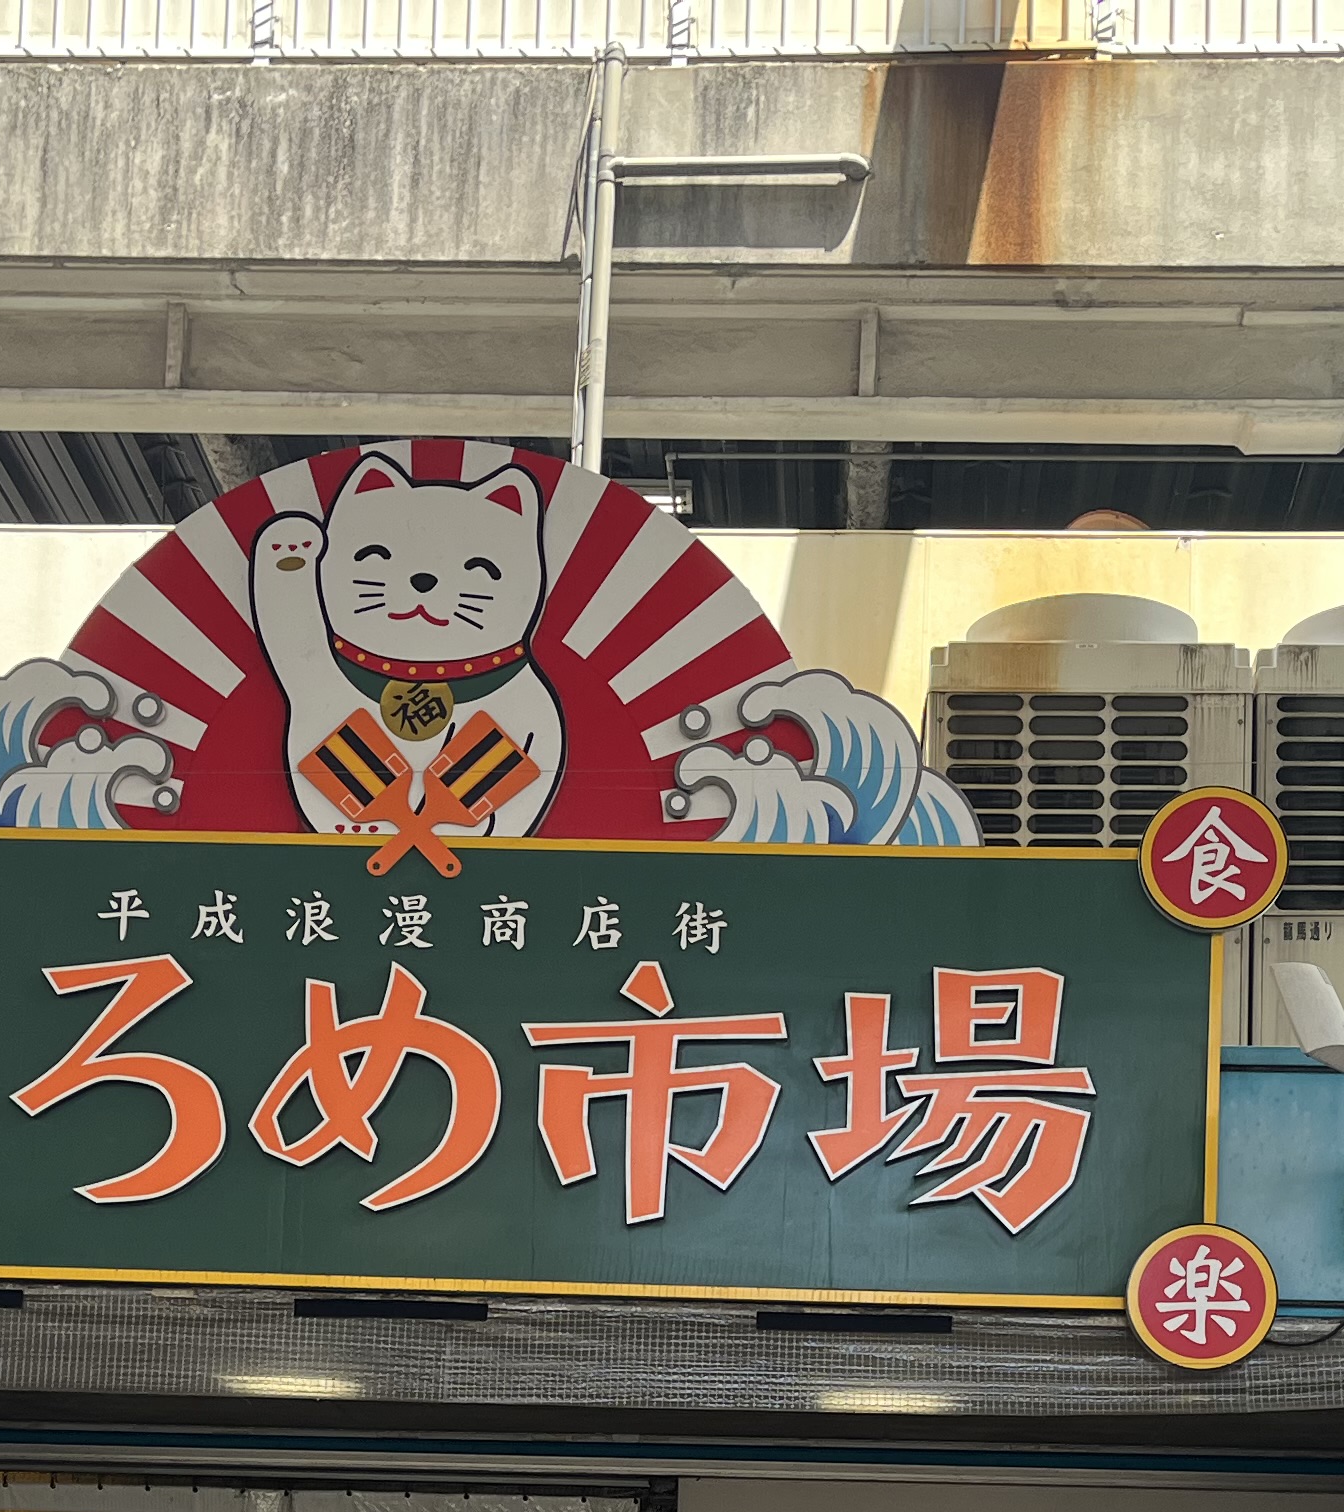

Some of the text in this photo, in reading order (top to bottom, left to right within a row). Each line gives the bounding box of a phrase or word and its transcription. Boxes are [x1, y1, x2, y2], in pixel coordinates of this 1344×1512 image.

[391, 682, 447, 735] 福
[1162, 804, 1268, 906] 食
[97, 889, 729, 955] 平成浪漫商店街
[1154, 1245, 1252, 1345] 楽
